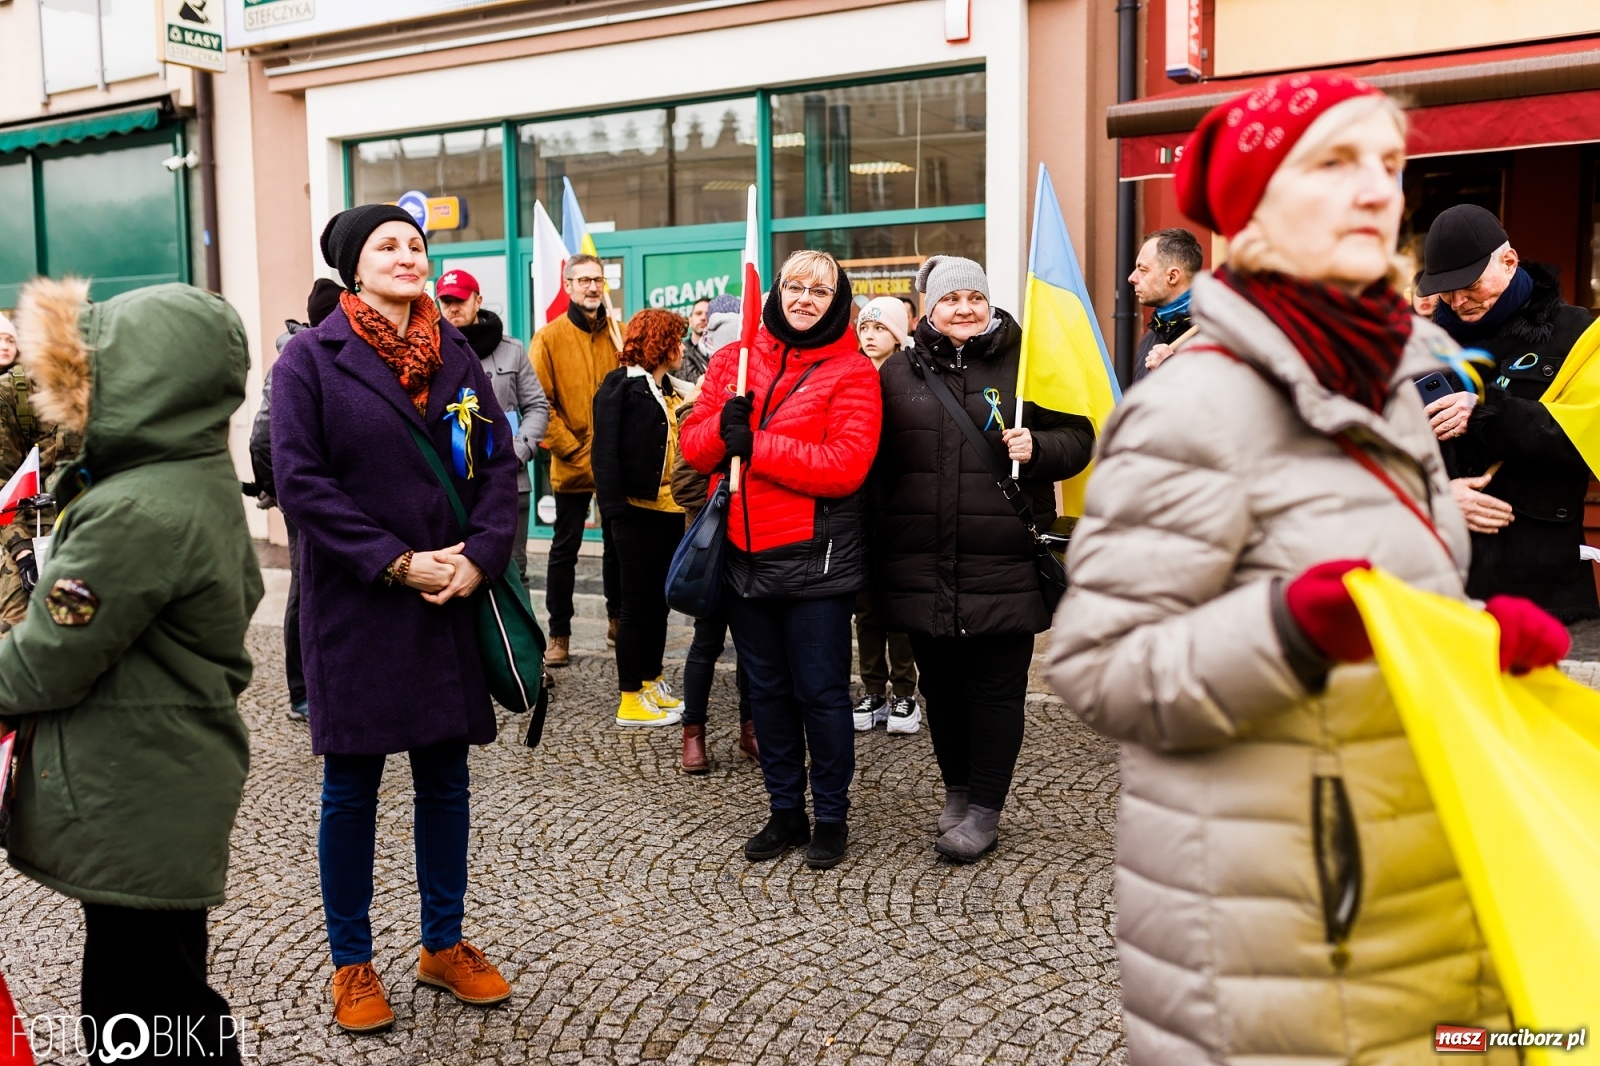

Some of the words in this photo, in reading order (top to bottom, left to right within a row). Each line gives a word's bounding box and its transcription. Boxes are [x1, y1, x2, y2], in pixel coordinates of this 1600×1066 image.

[247, 3, 313, 27] STEFCZYKA
[184, 29, 220, 50] KASY
[649, 275, 730, 309] GRAMY
